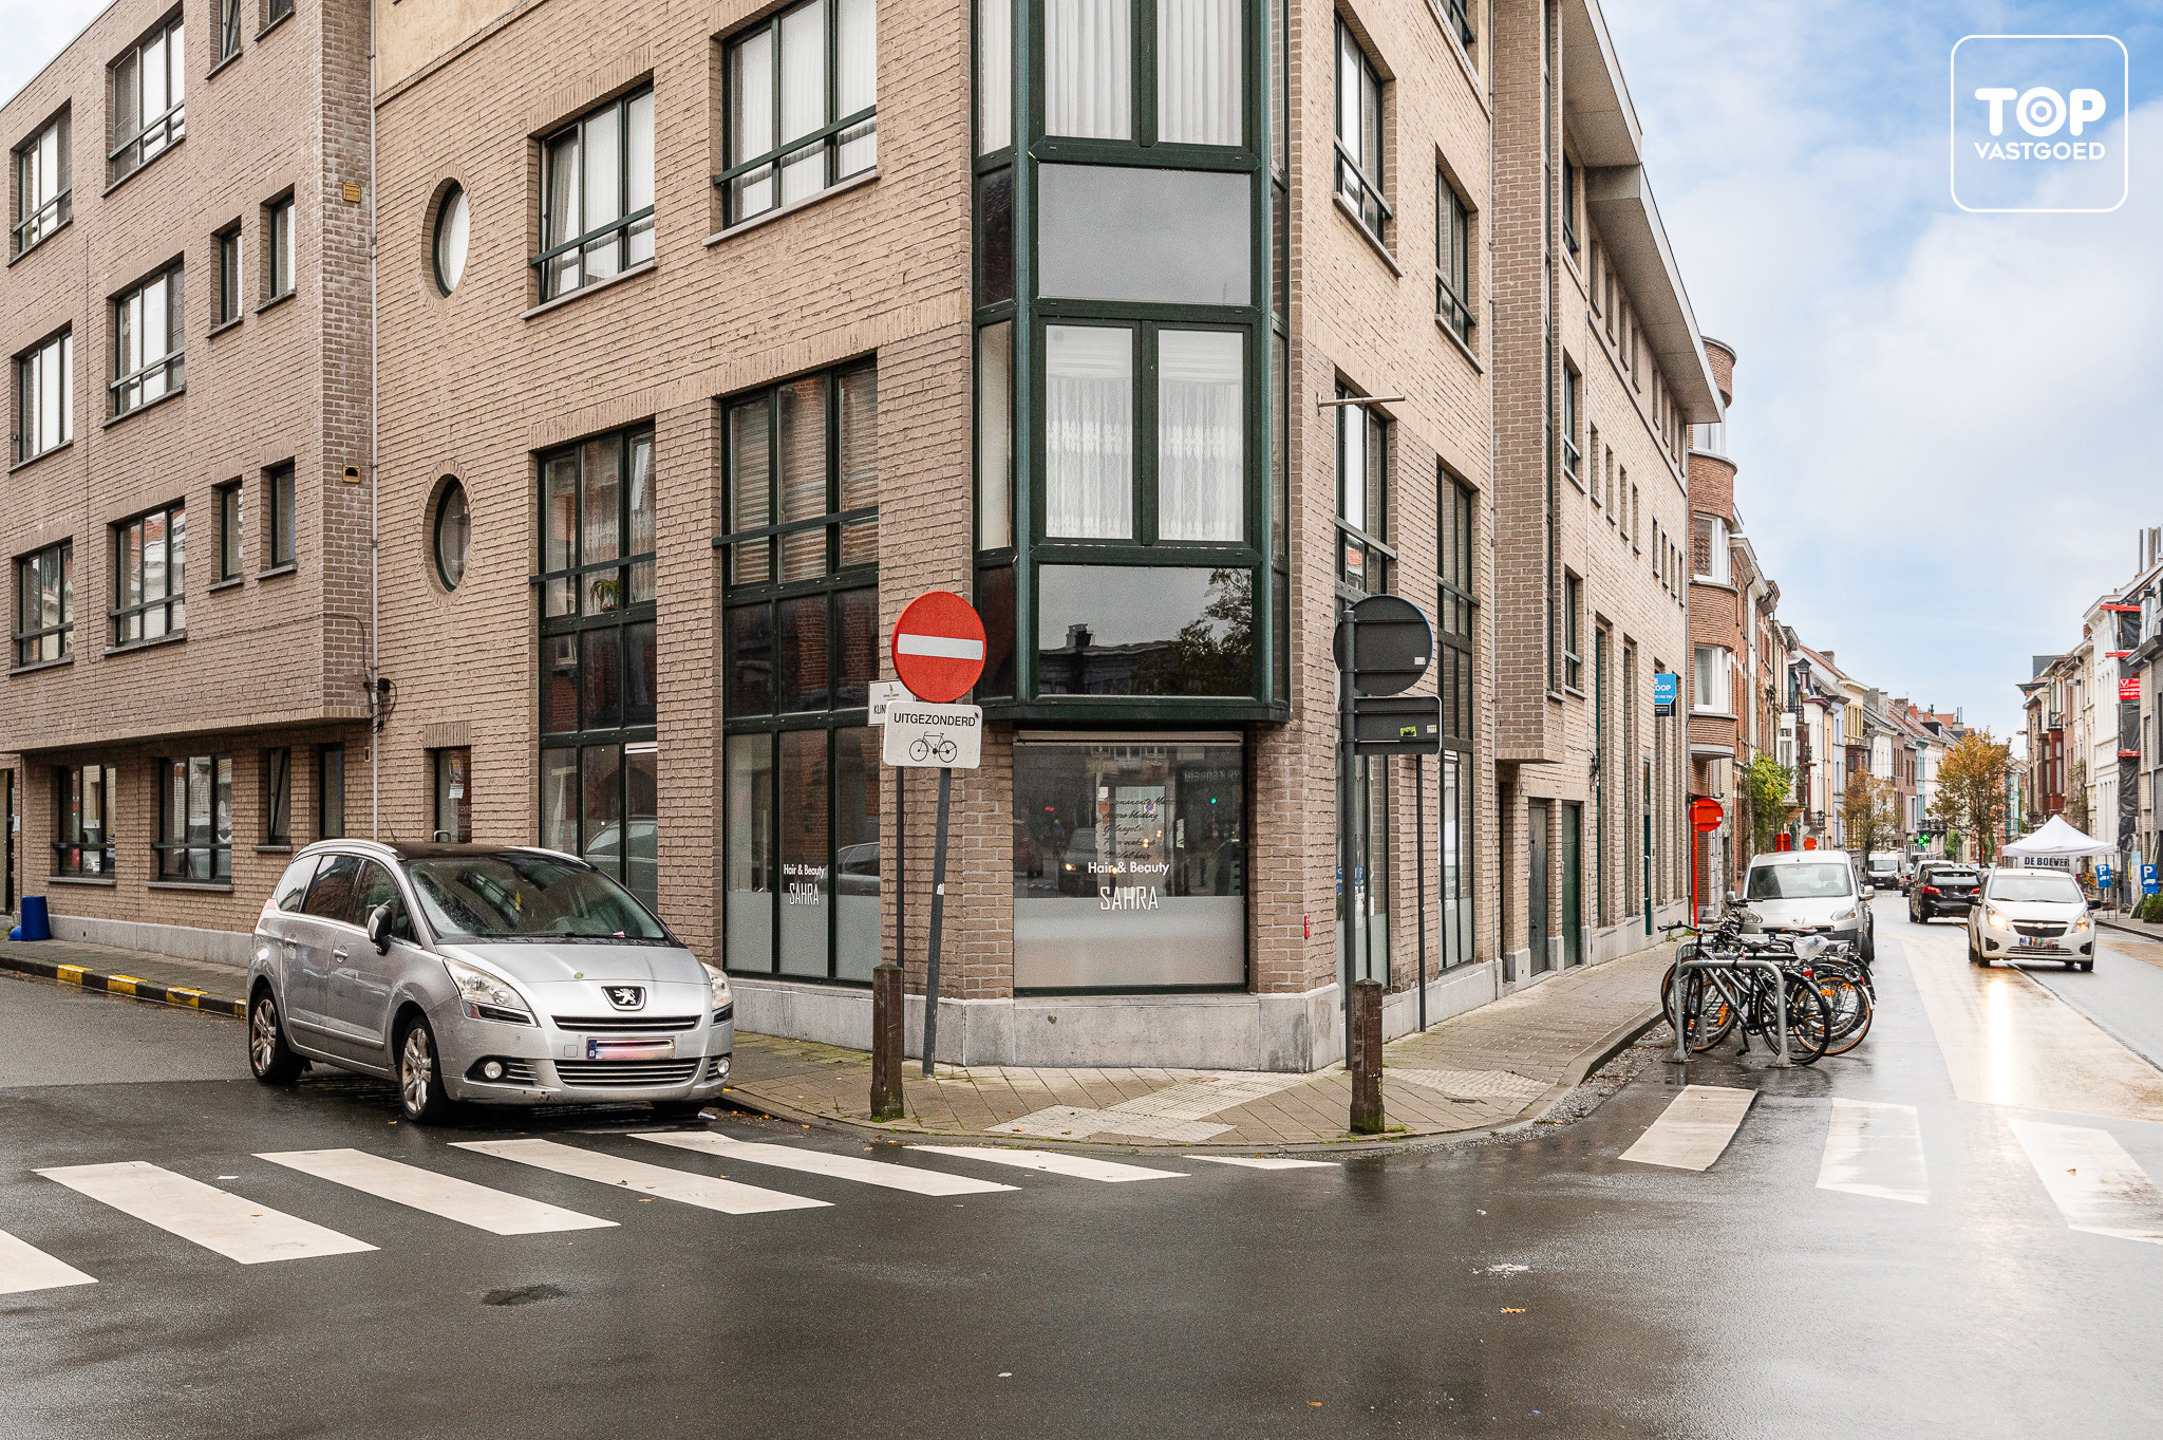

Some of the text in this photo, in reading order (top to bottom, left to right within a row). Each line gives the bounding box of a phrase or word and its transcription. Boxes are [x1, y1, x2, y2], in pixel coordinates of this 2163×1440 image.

[894, 713, 976, 726] UITGEZONDERD
[2024, 857, 2035, 865] DE
[783, 864, 826, 878] Hair & Beauty
[1088, 862, 1170, 876] Hair & Beauty
[2143, 866, 2153, 878] P
[789, 883, 819, 905] SAHRA
[1100, 886, 1159, 911] SAHRA
